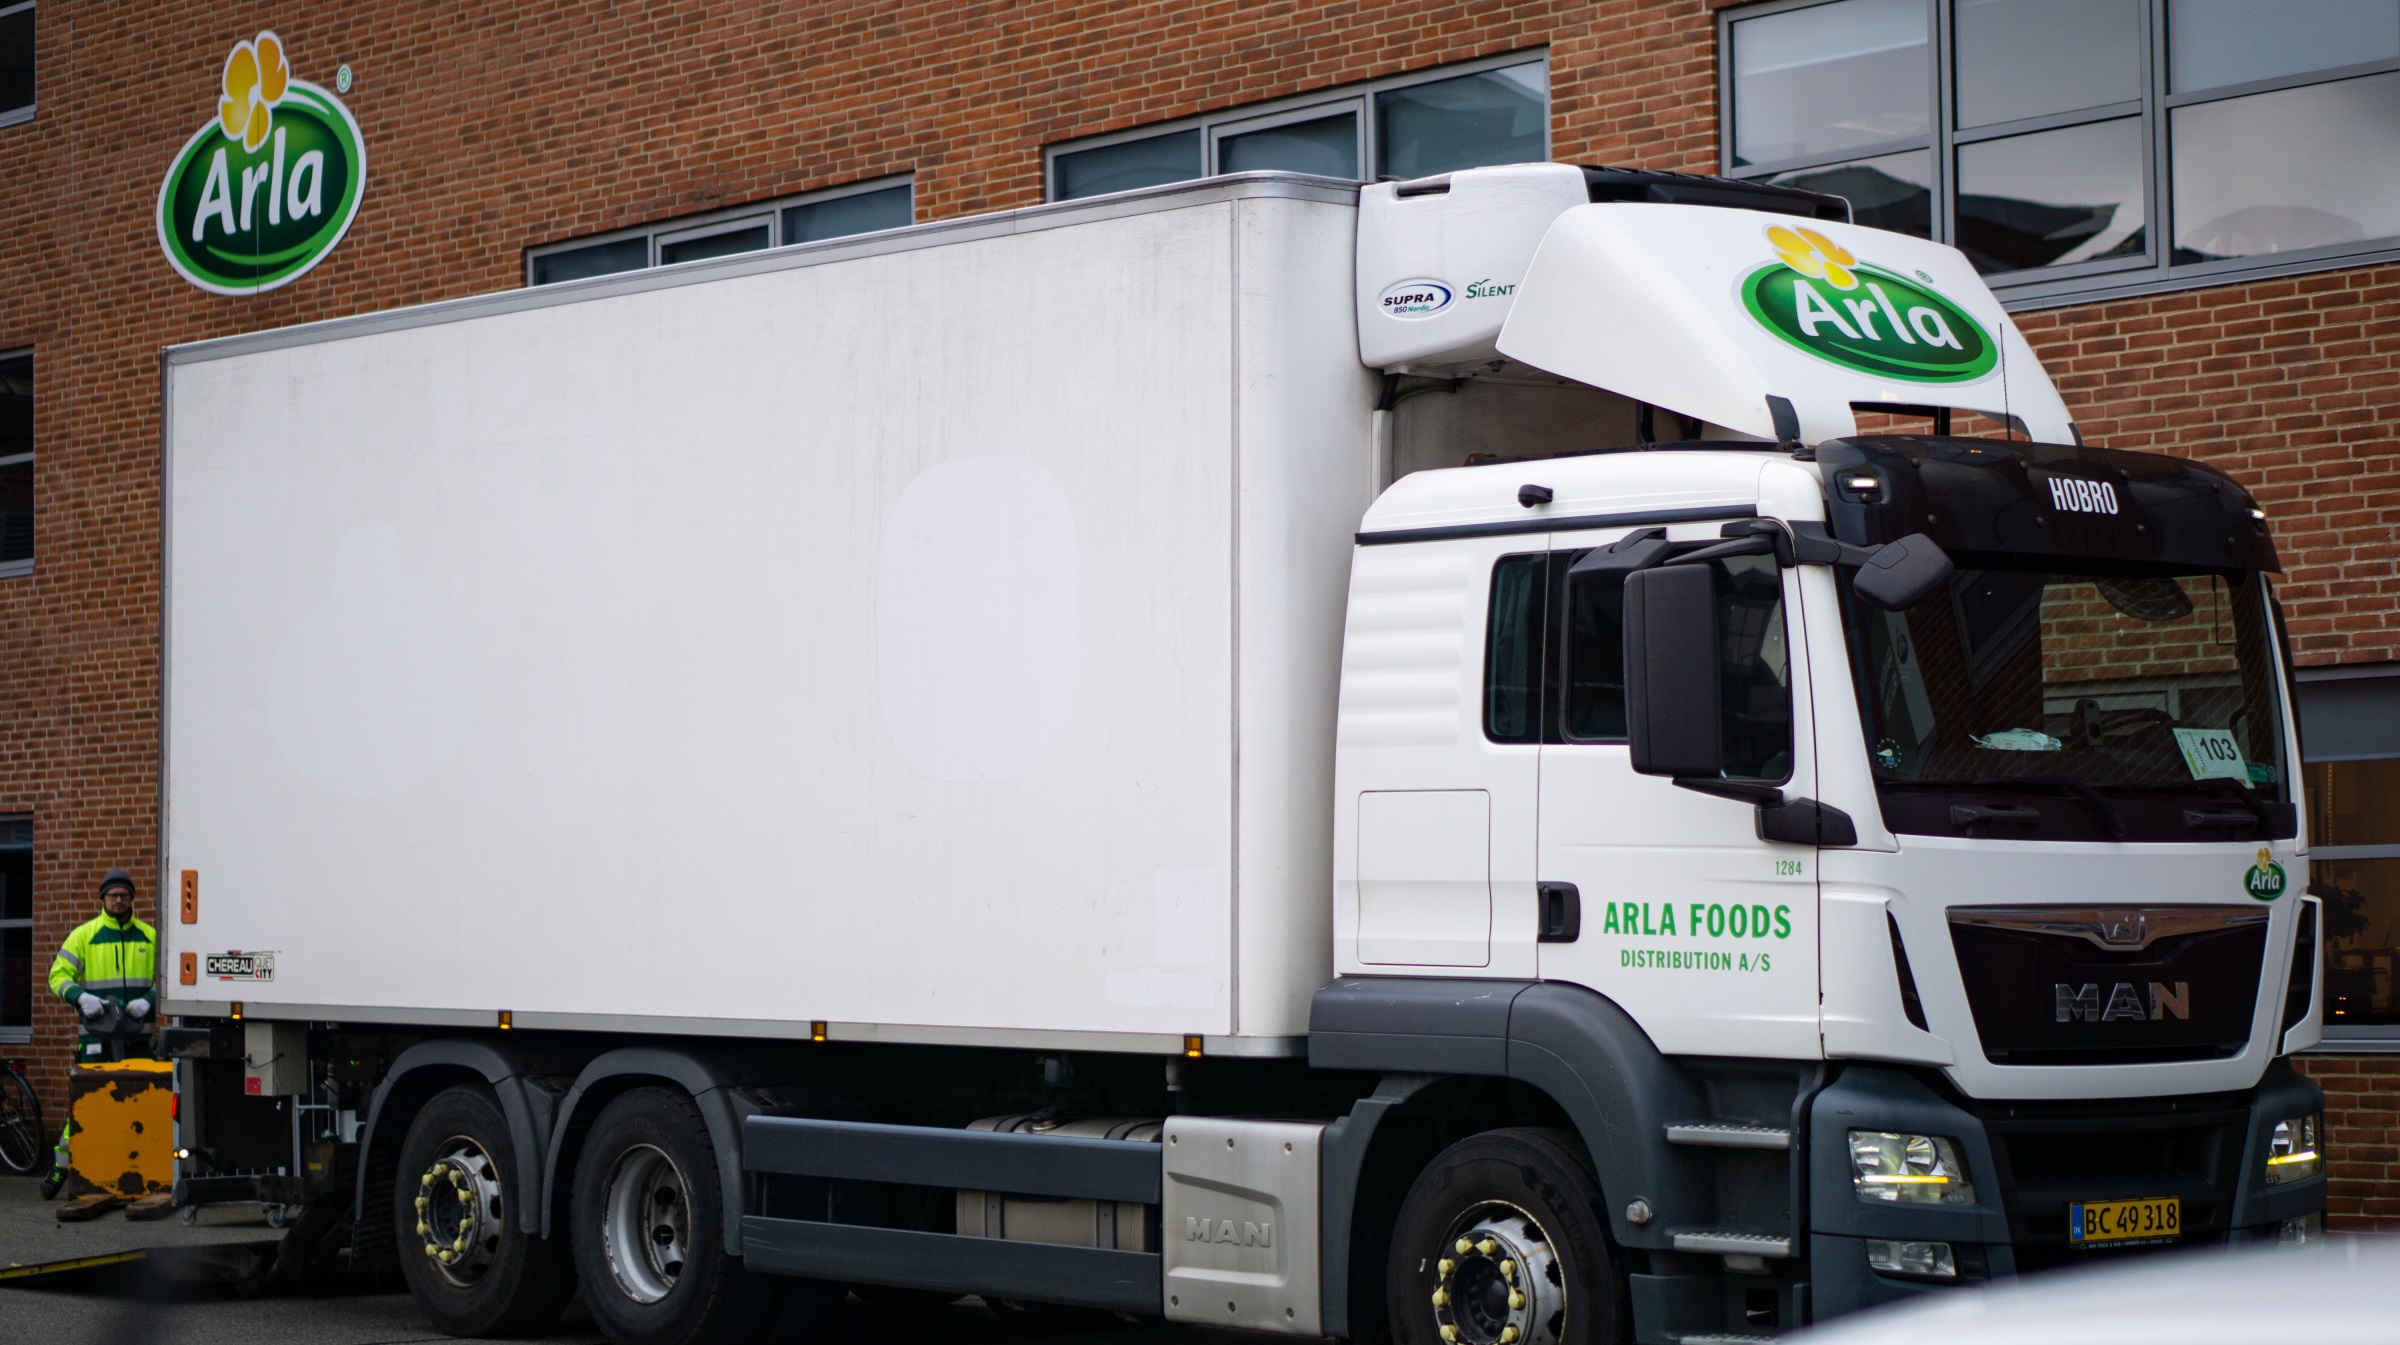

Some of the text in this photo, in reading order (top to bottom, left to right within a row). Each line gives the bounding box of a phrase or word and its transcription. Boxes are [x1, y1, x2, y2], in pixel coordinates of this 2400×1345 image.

[192, 126, 324, 242] Arla
[1383, 293, 1435, 307] SUPRA
[1394, 304, 1430, 314] 850 Nordic
[1793, 279, 1964, 351] Arla
[2048, 477, 2118, 515] HOBRO
[2200, 737, 2237, 761] 103
[1775, 860, 1802, 876] 1284
[2250, 869, 2281, 892] Arla
[1603, 901, 1792, 939] ARLA FOODS
[208, 958, 253, 973] CHEREAU
[1620, 949, 1771, 973] DISTRIBUTION A/S
[255, 968, 273, 979] CITY
[2055, 982, 2190, 1022] MAN
[2086, 1202, 2177, 1235] BC 49 318
[1186, 1216, 1270, 1248] MAN
